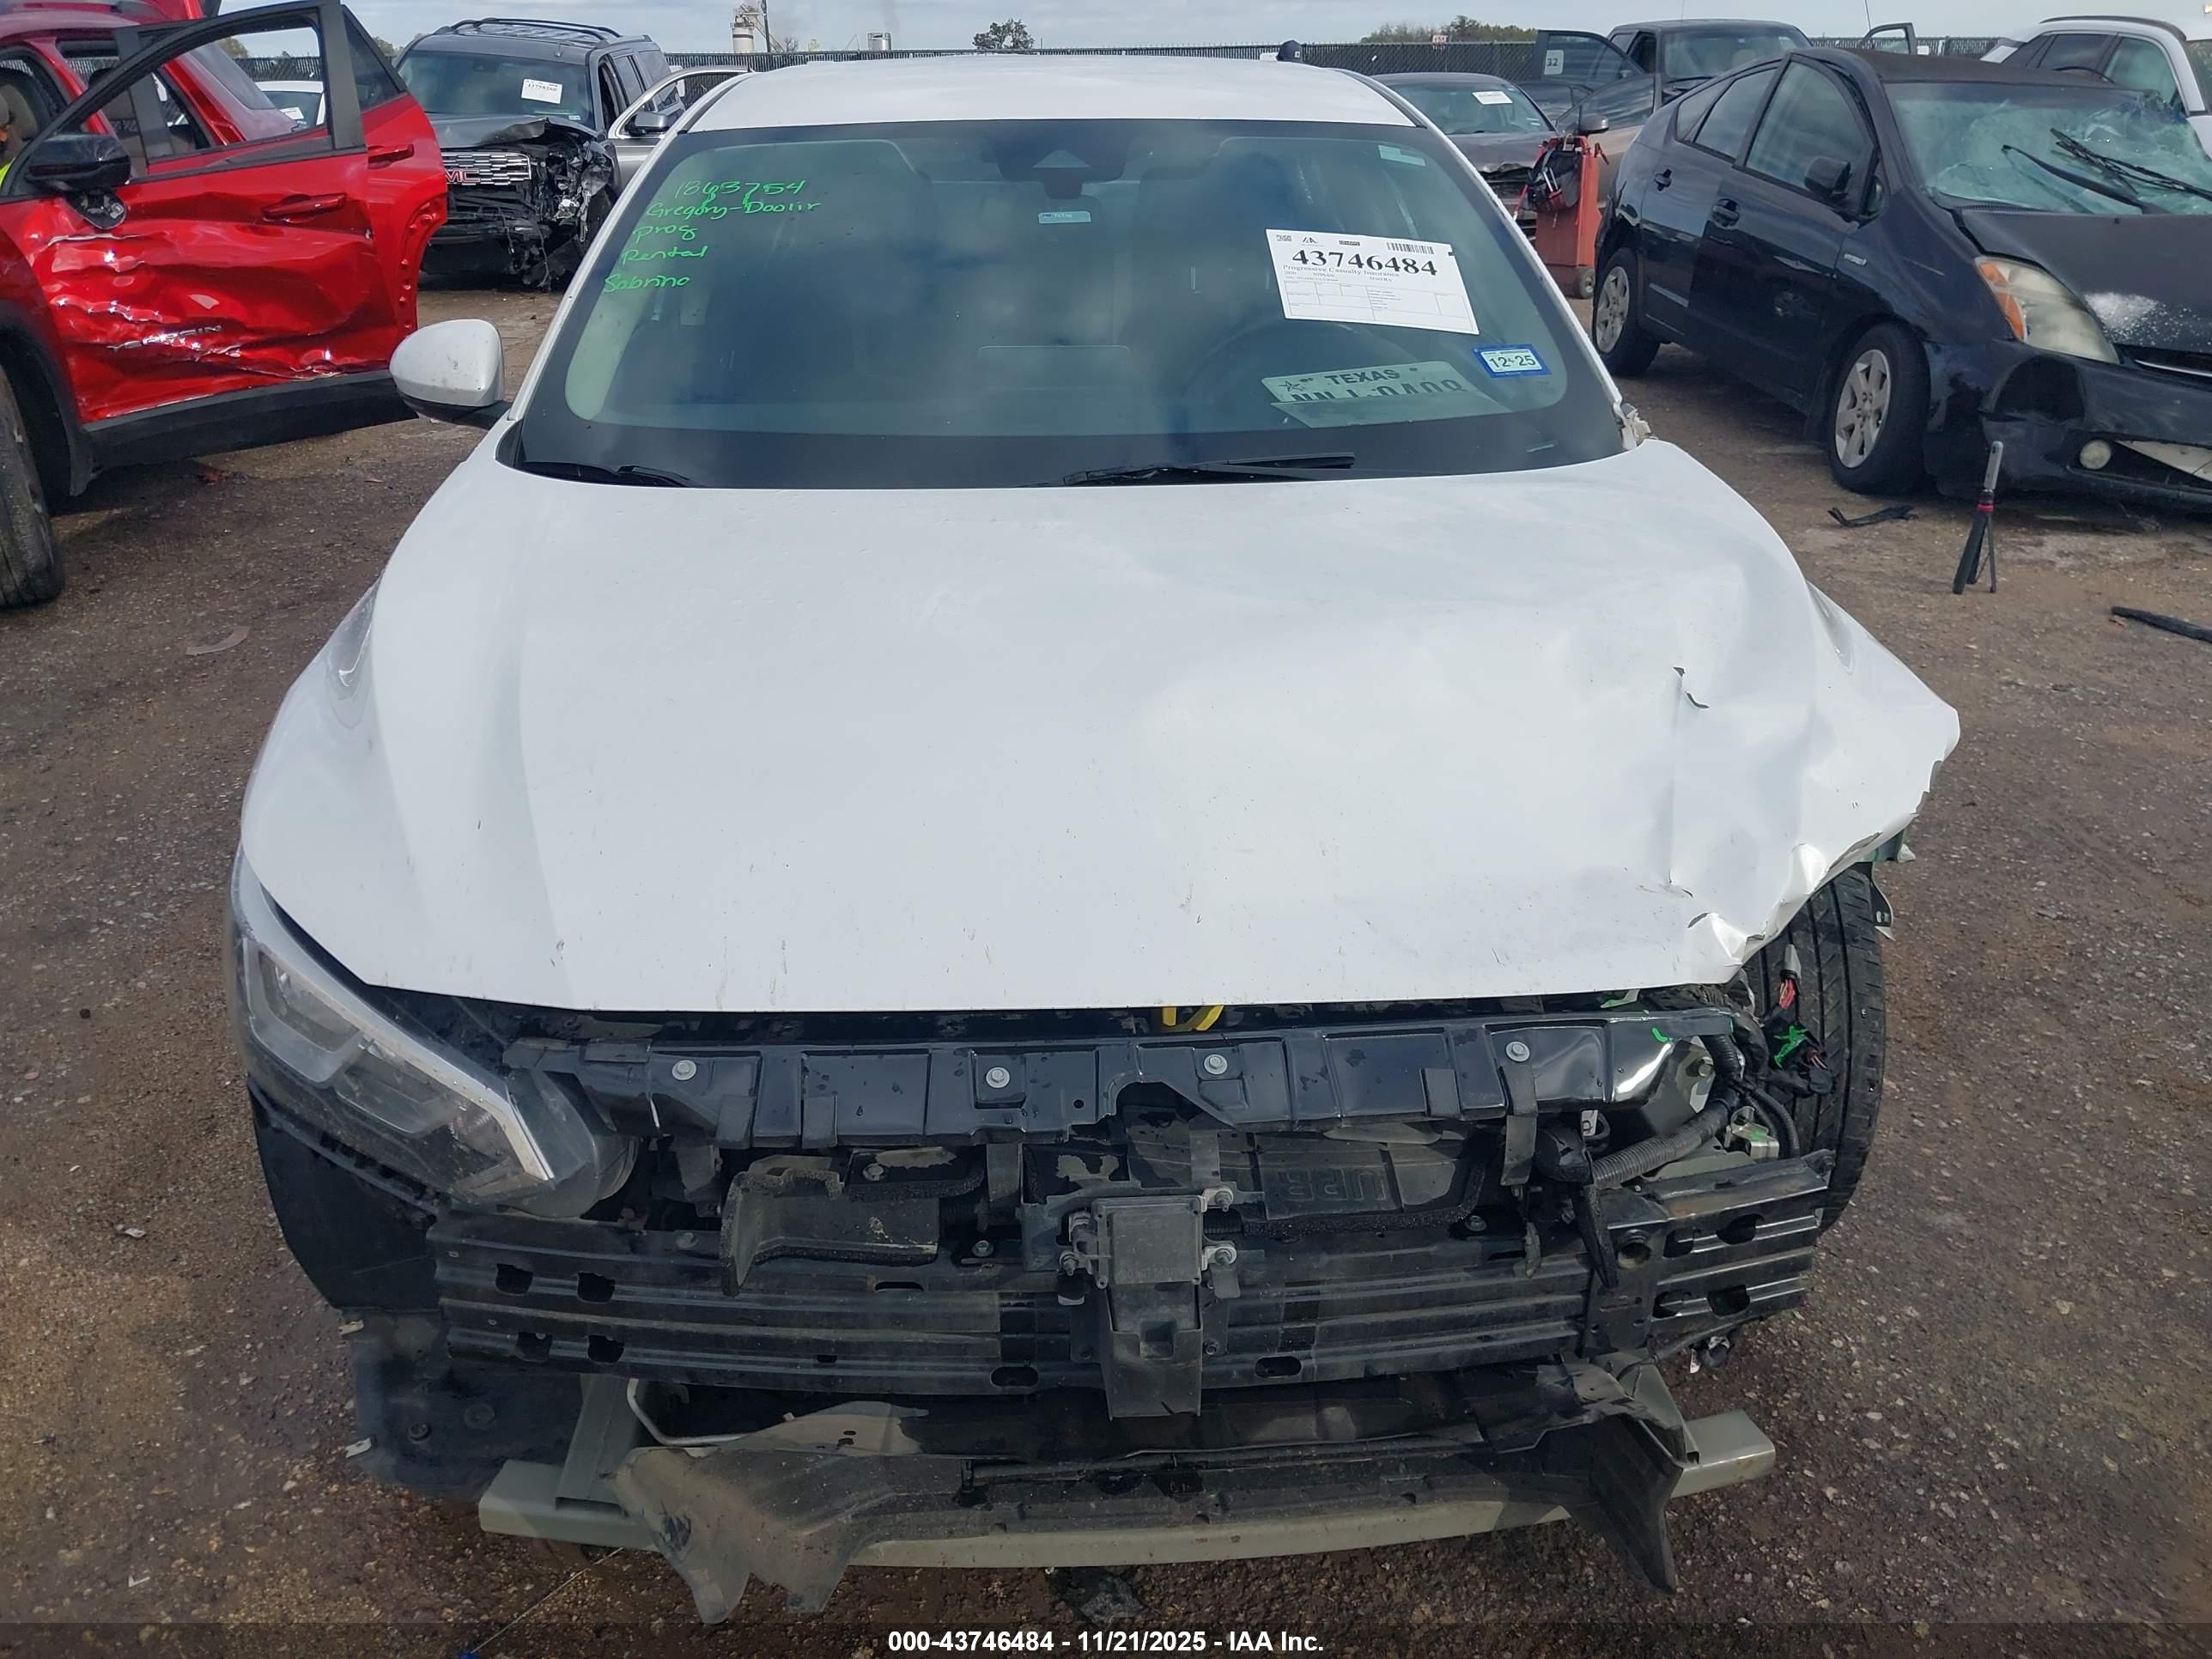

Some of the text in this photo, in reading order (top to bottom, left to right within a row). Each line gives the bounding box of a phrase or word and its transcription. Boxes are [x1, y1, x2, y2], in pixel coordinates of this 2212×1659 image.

[444, 167, 481, 183] MC
[1283, 264, 1327, 273] Progressive
[1291, 249, 1438, 276] 43746484
[1324, 368, 1401, 386] TEXAS
